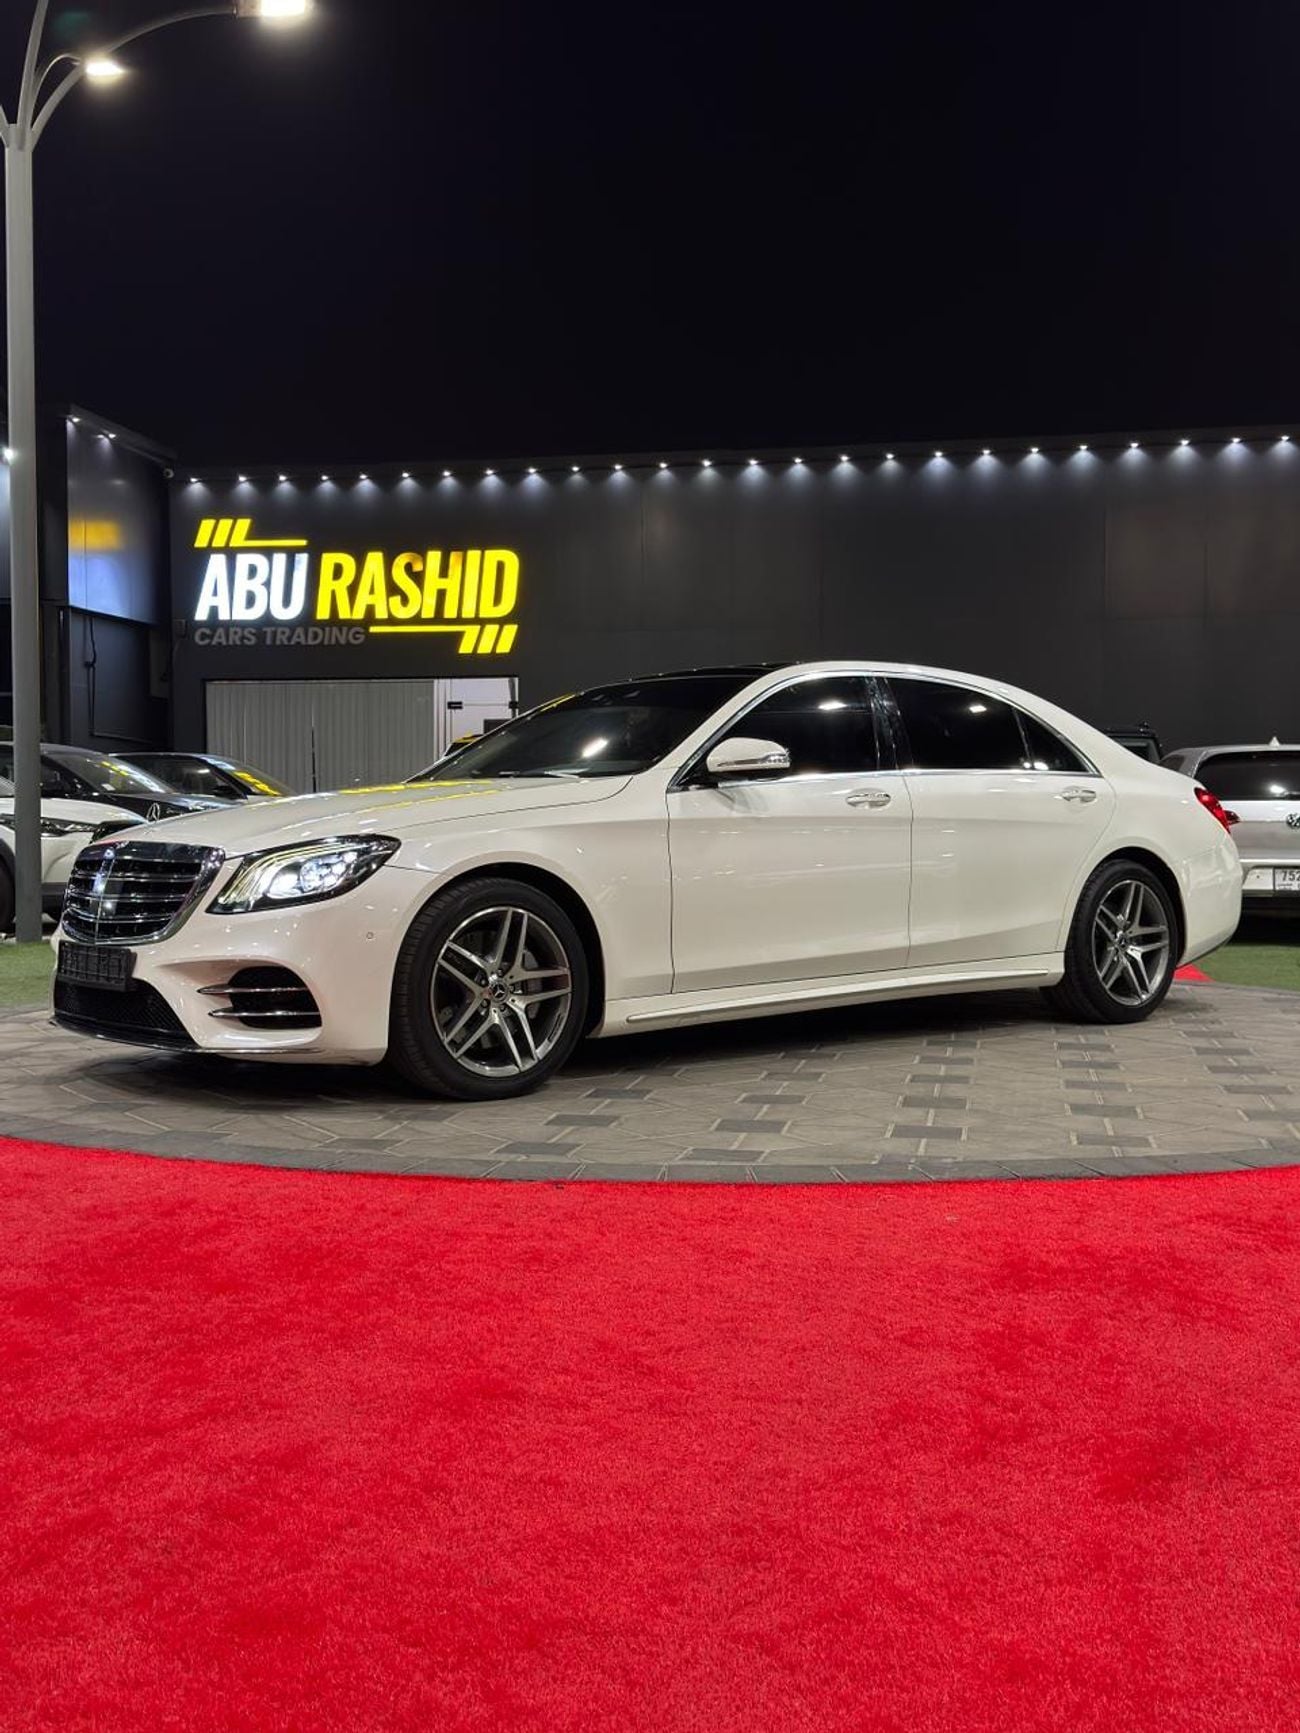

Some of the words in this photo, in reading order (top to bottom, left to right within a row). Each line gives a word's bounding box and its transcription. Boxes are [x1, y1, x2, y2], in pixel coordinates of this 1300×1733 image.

[194, 553, 309, 620] ABU
[316, 550, 520, 619] RASHID
[194, 627, 257, 645] CARS
[263, 626, 366, 645] TRADING
